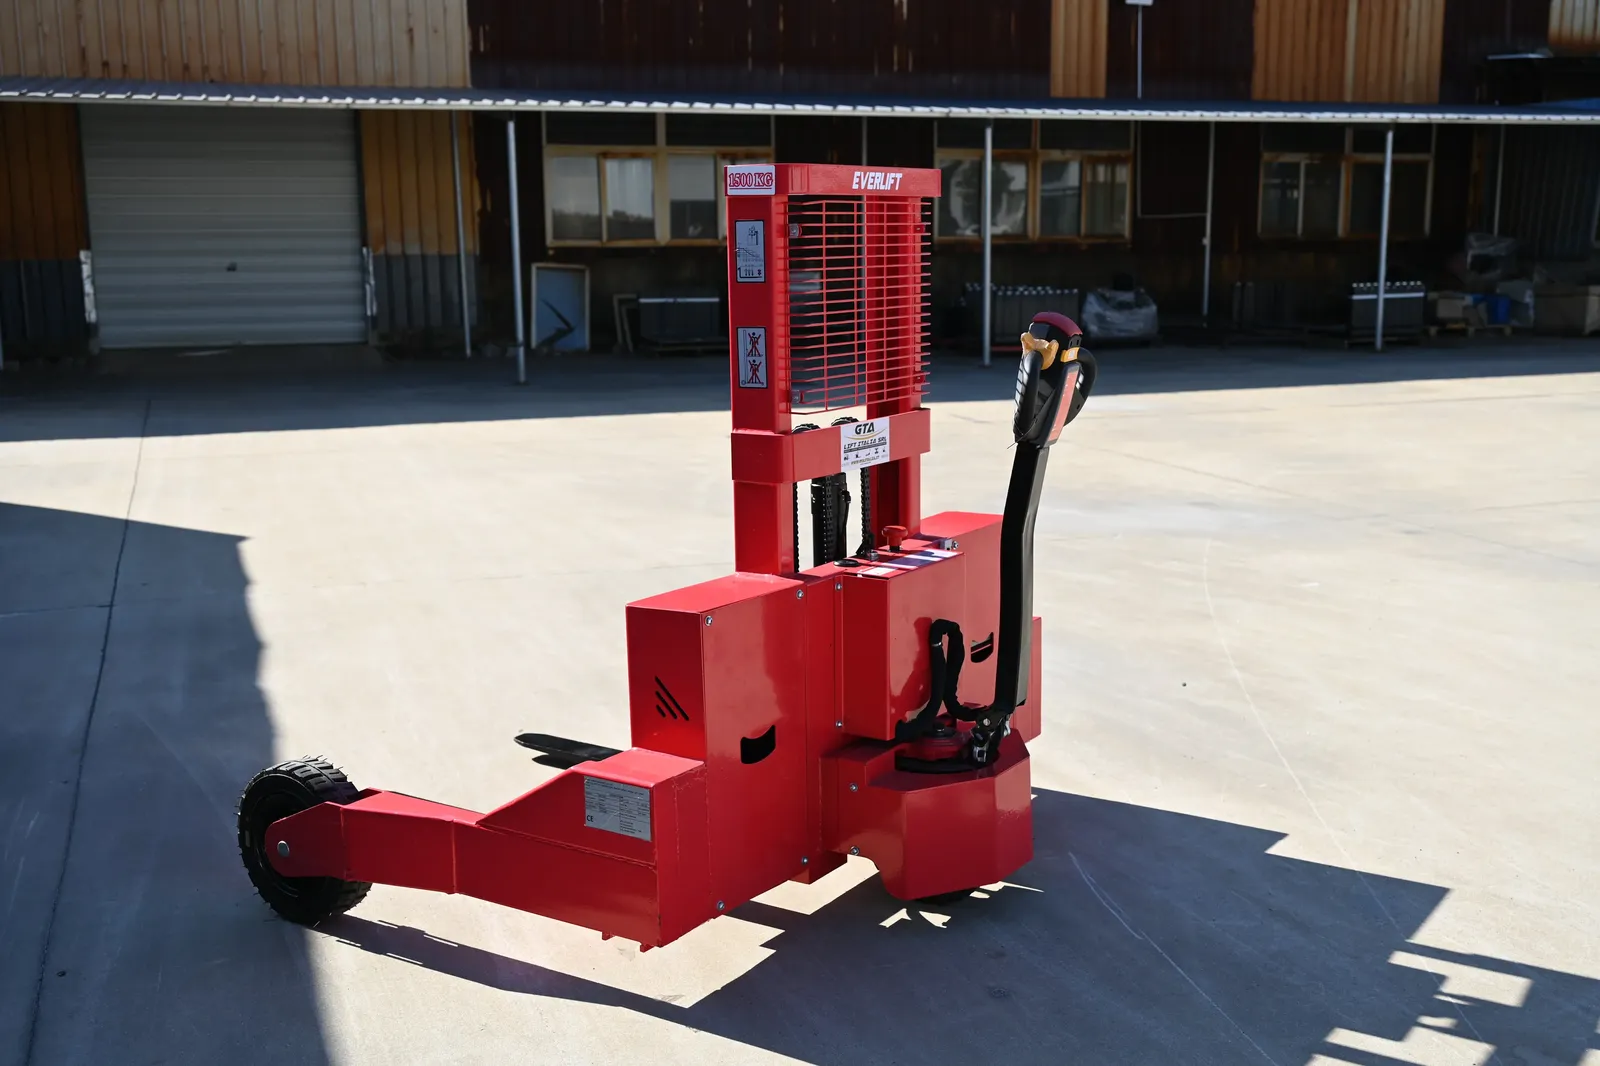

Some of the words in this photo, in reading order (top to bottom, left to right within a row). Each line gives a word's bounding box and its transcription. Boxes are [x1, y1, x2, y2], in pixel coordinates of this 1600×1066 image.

[729, 173, 753, 187] 1500
[754, 172, 773, 187] KG
[852, 171, 903, 191] EVERLIFT
[855, 422, 875, 435] GTA
[843, 442, 857, 450] LIFT
[857, 438, 876, 447] ITALIA
